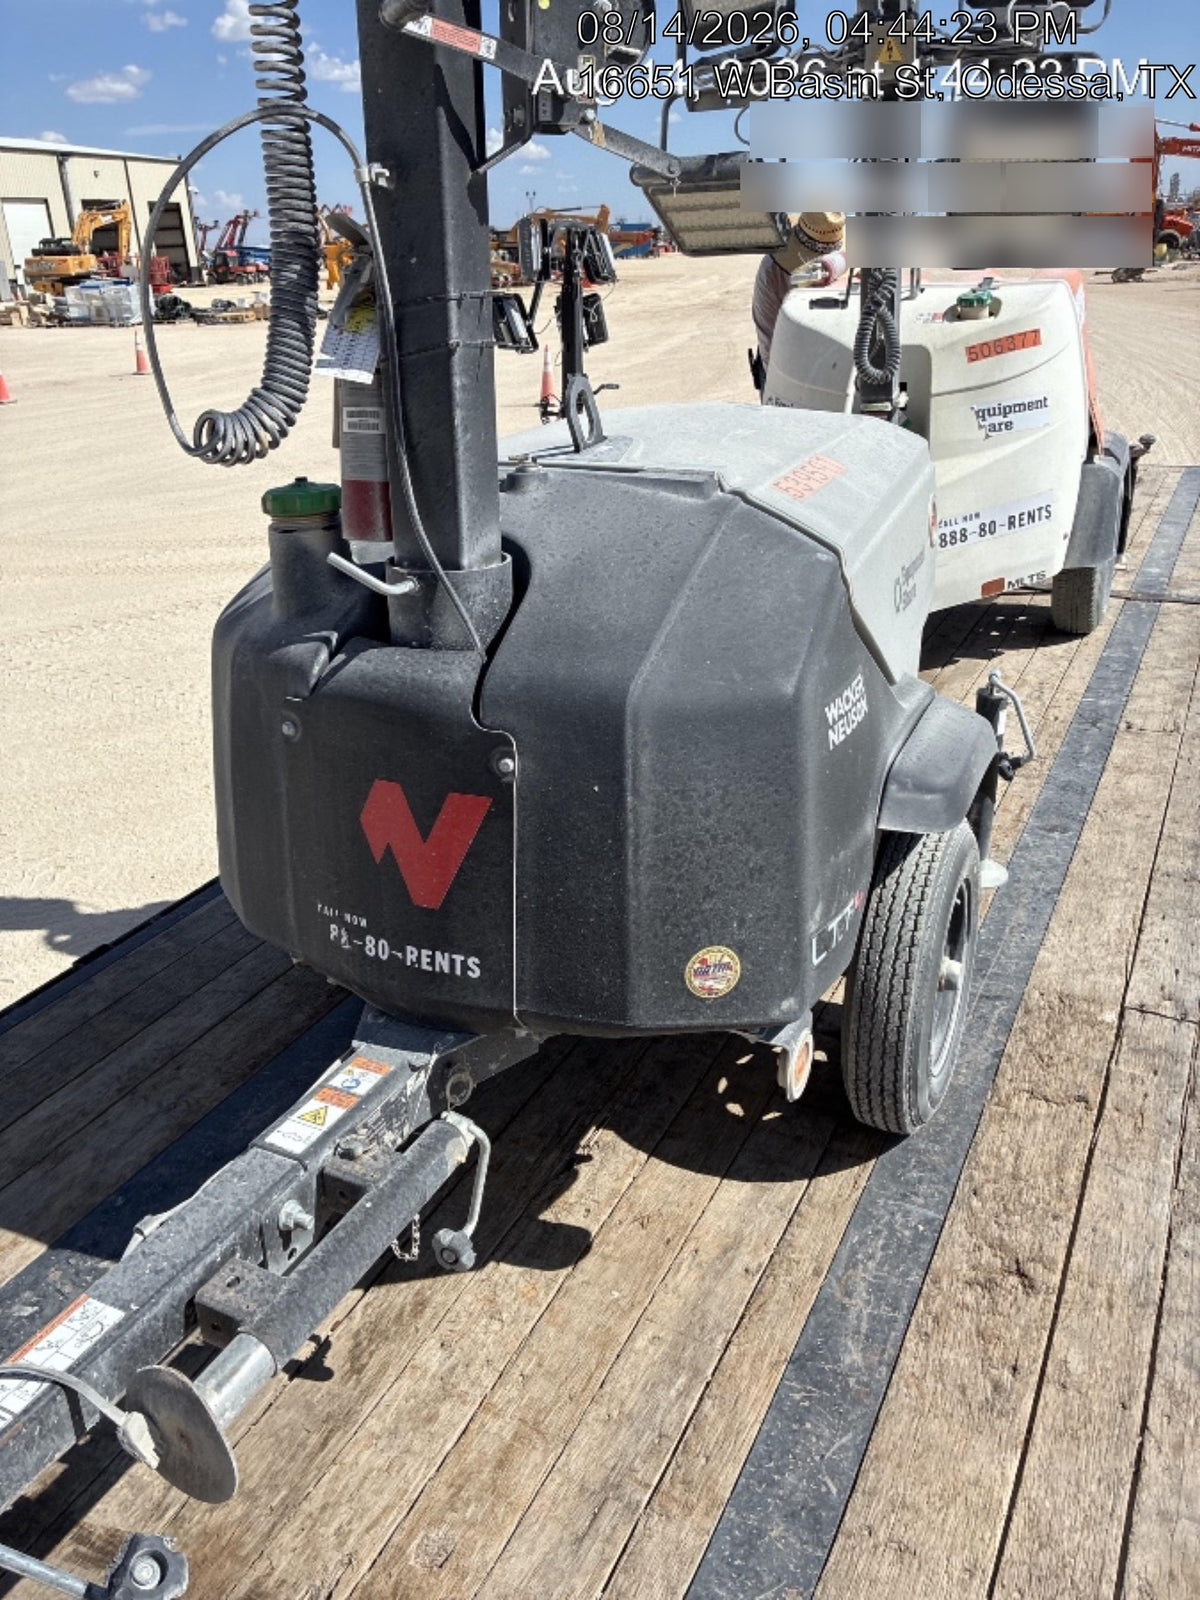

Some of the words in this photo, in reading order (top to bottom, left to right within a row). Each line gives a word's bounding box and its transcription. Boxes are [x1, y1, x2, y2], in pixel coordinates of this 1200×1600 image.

[966, 328, 1040, 362] 506377
[824, 673, 865, 727] WACKER
[828, 693, 868, 751] NEUSON
